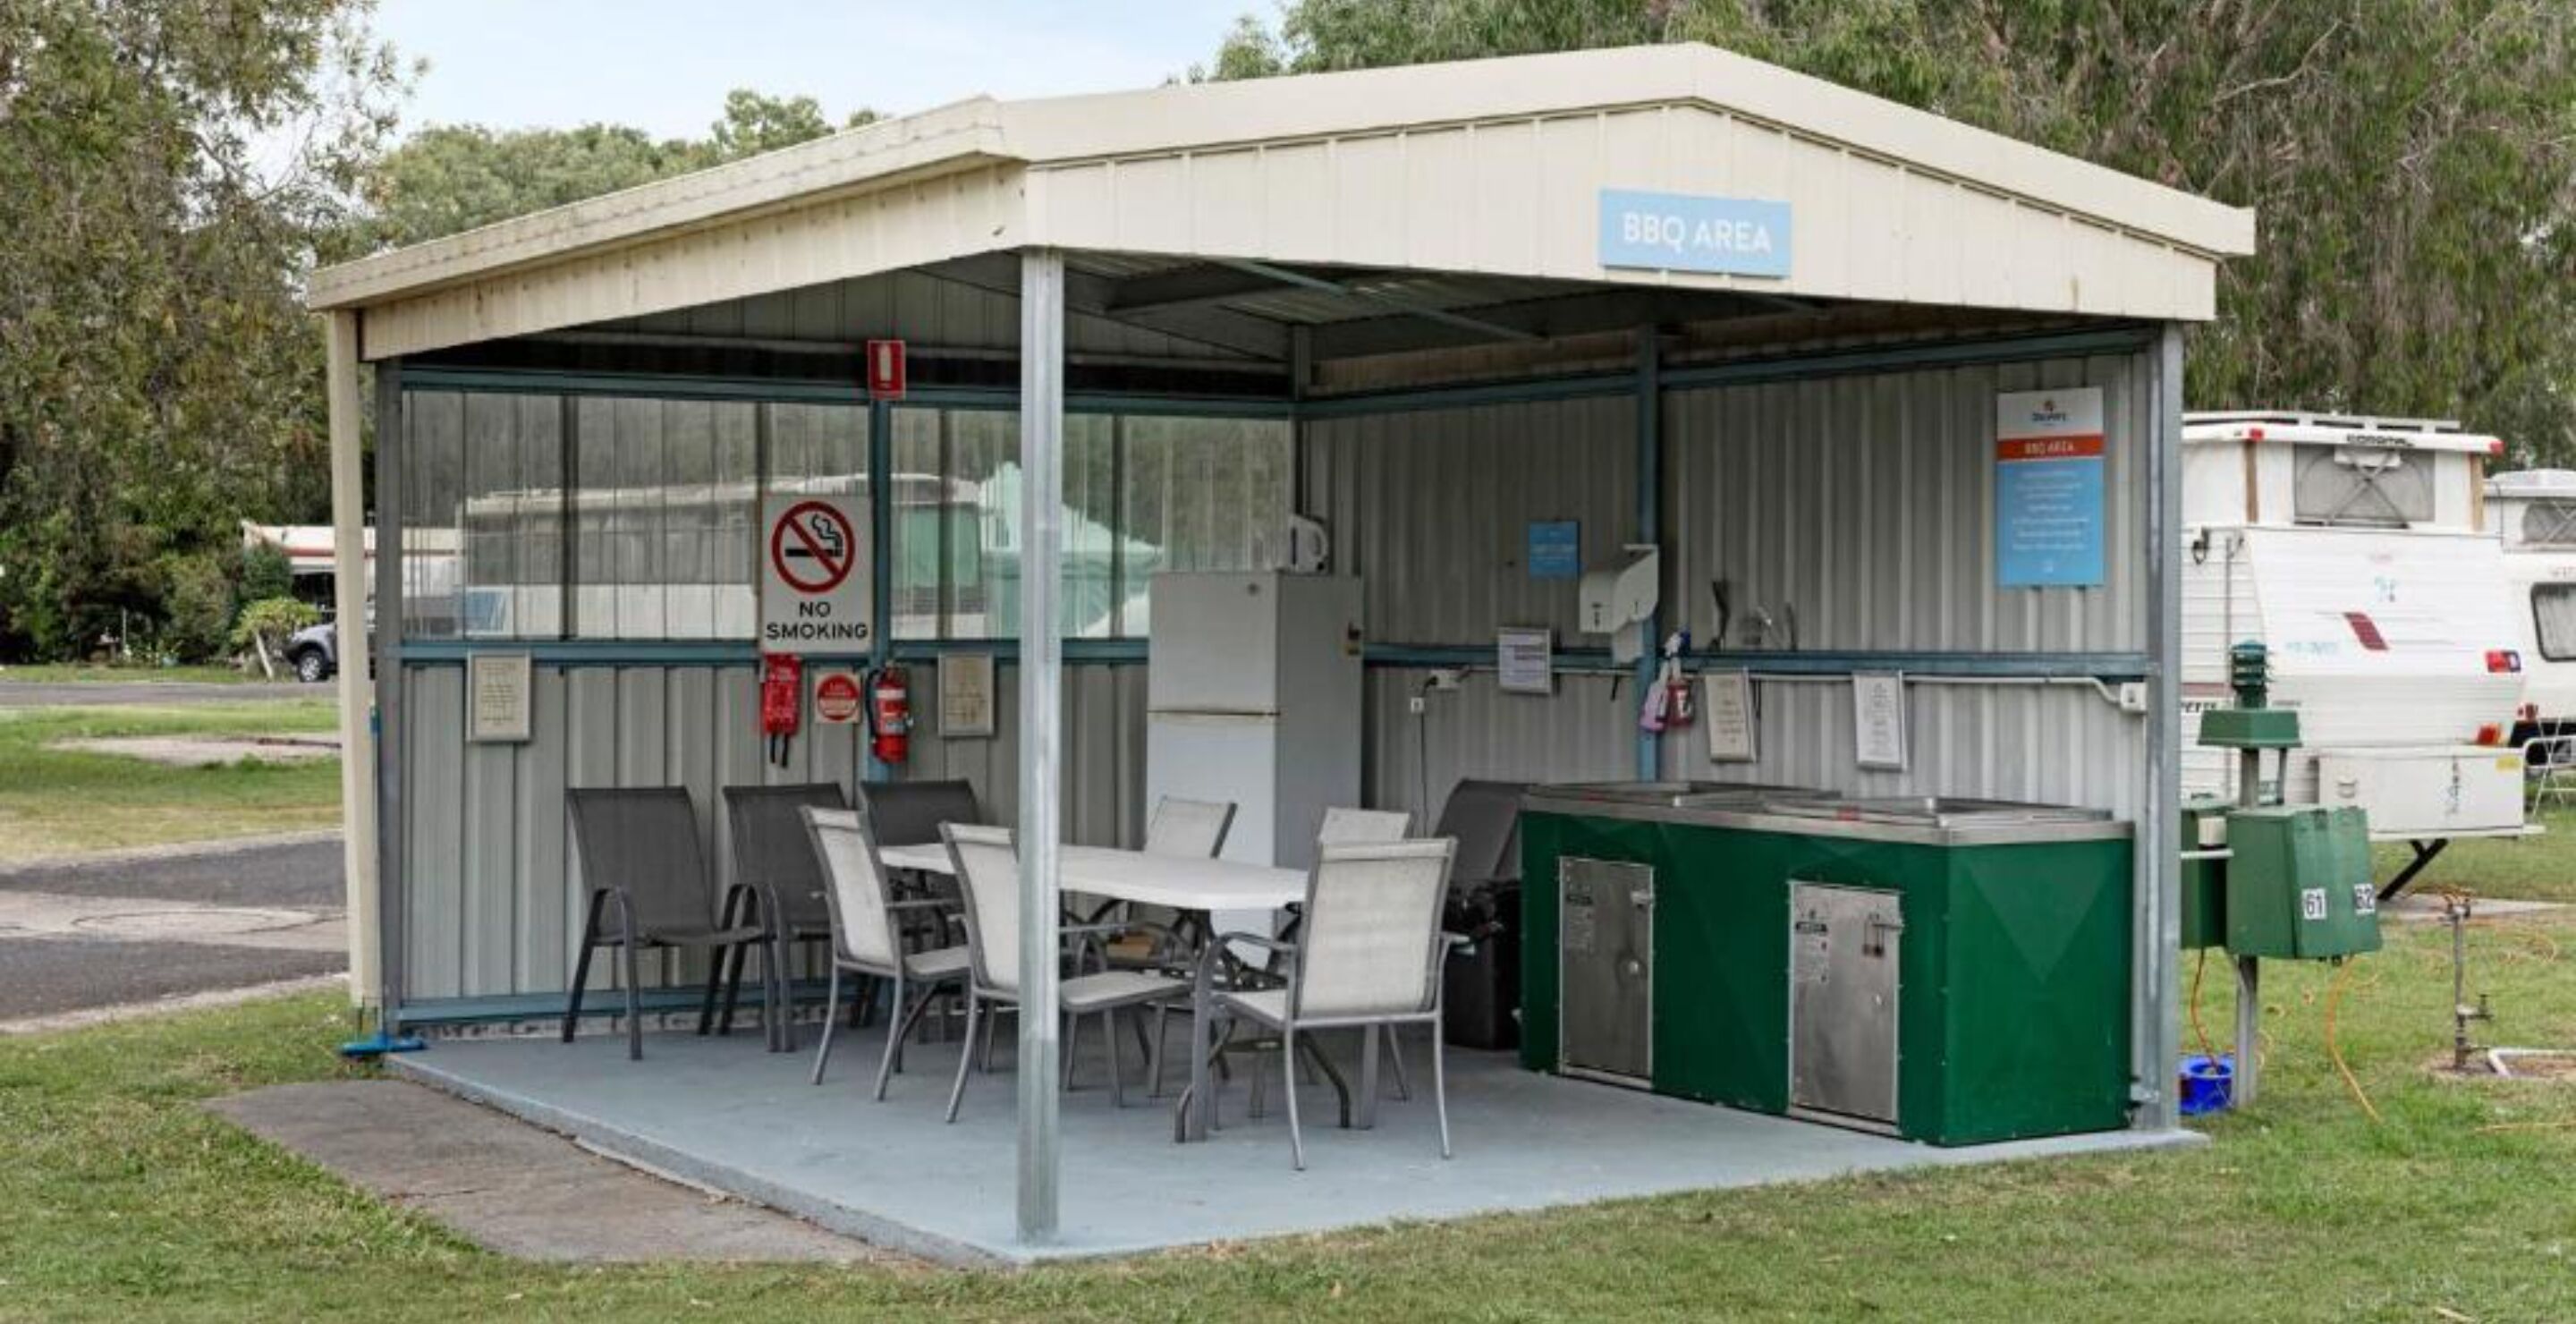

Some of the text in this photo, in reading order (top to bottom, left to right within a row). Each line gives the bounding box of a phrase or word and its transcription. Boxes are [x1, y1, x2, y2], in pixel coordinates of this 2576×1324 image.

[1623, 211, 1771, 254] BBQ AREA
[2047, 440, 2074, 453] AREA
[799, 600, 831, 618] NO
[766, 622, 869, 641] SMOKING
[2306, 893, 2323, 916] 61
